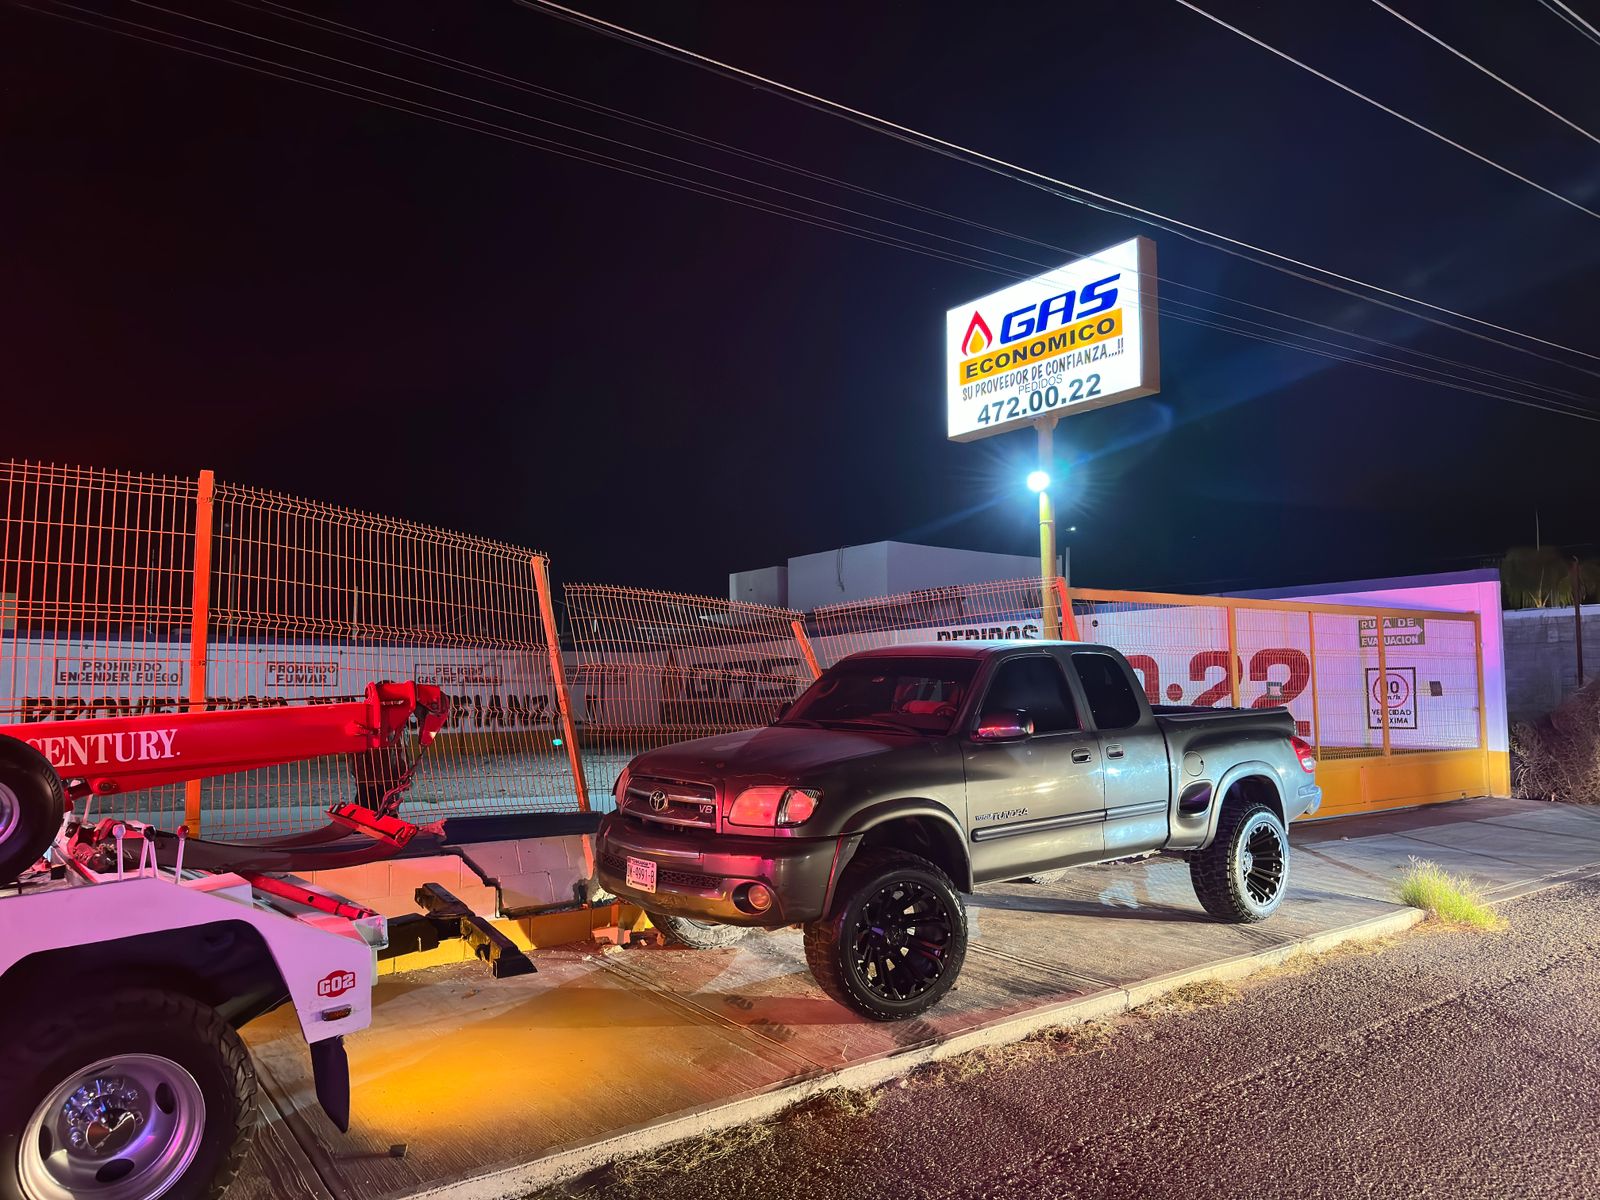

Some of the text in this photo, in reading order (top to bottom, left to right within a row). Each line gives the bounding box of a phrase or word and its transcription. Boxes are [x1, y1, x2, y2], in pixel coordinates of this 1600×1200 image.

[1000, 273, 1121, 345] GAS
[966, 317, 1115, 379] ECONOMICO
[962, 386, 973, 402] SU
[975, 368, 1028, 397] PROVEEDOR
[1031, 365, 1043, 381] DE
[1018, 373, 1063, 396] PEDIDOS
[977, 373, 1102, 425] 472.00.22
[1361, 618, 1415, 629] RUA DE
[1361, 635, 1419, 647] EVAUACION
[82, 661, 162, 673] PROHIBIDO
[269, 665, 336, 675] PROHIBIDO
[60, 671, 179, 683] ENCENDER FUEGO
[276, 674, 327, 684] FUMAR
[699, 804, 714, 814] V8
